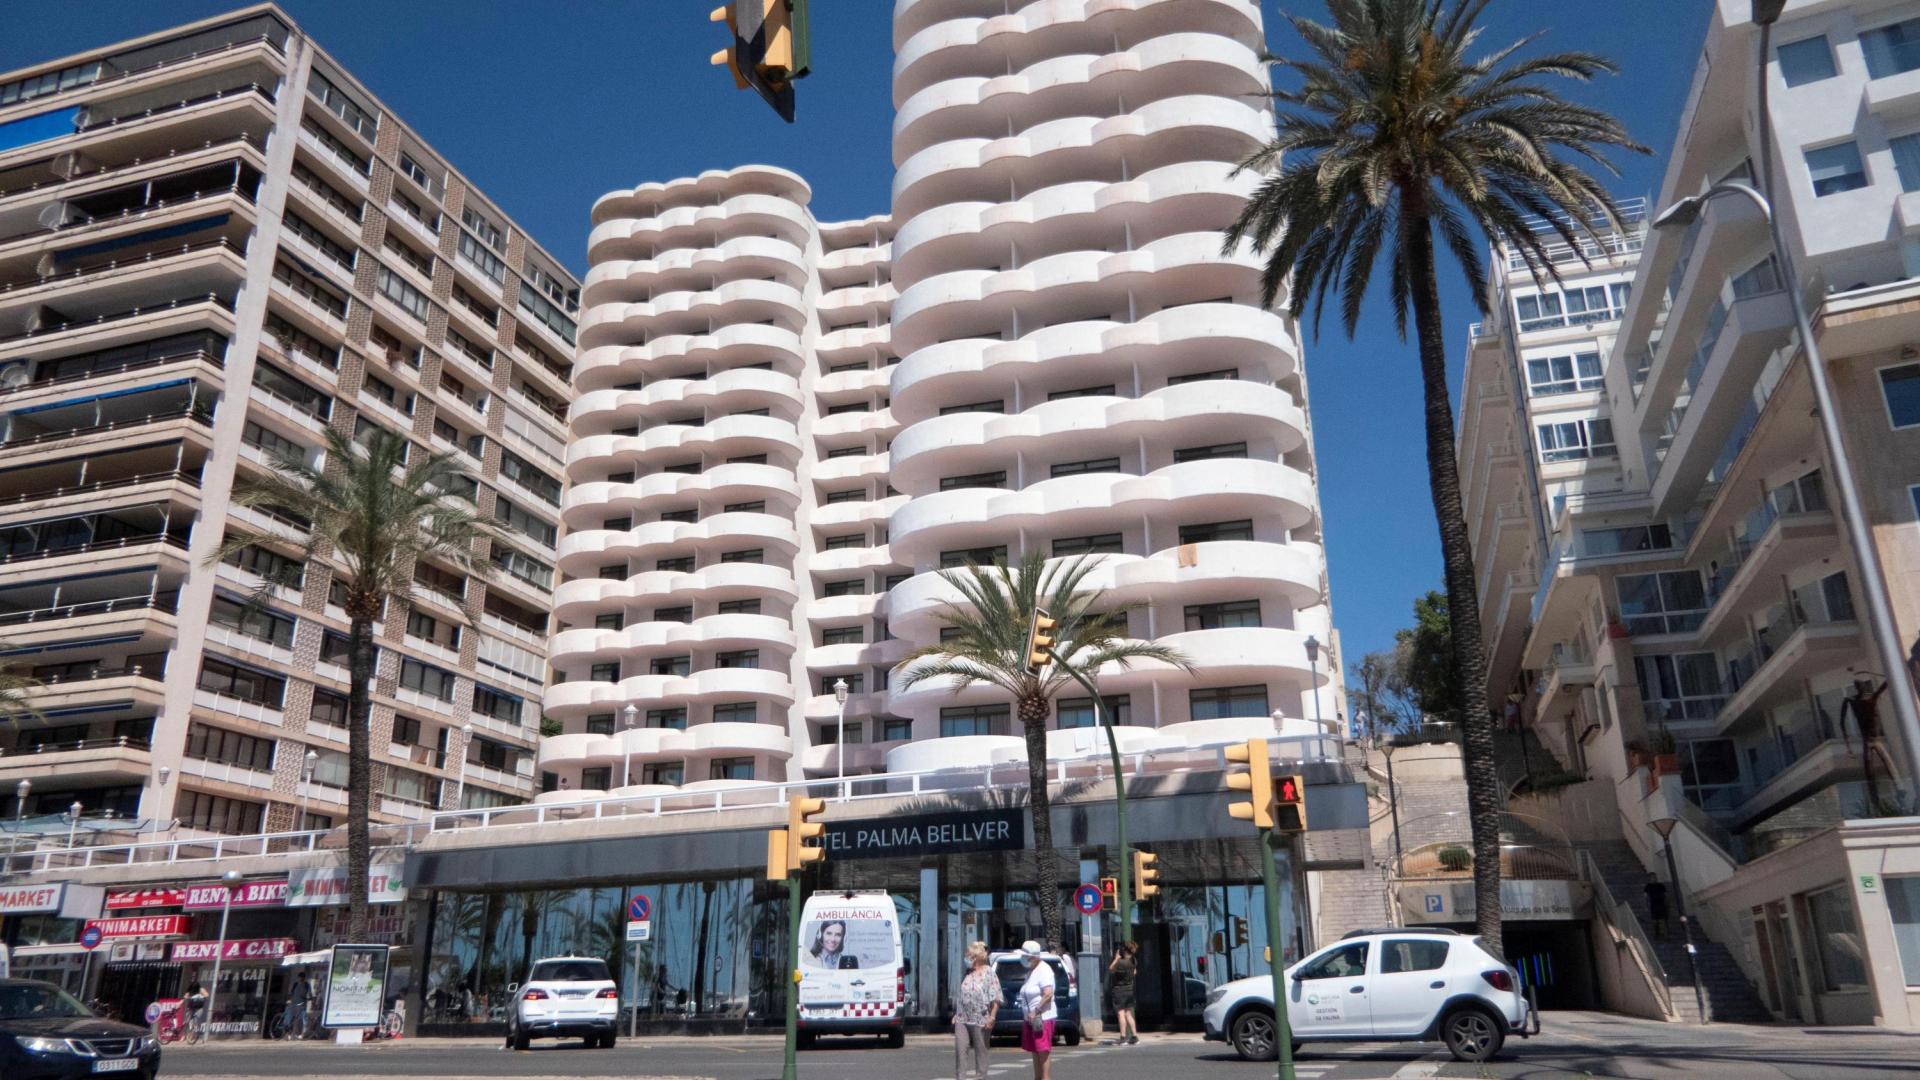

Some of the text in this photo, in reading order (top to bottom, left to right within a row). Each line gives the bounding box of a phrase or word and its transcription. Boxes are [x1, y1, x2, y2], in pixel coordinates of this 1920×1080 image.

[857, 827, 922, 849] PALMA
[927, 821, 1010, 844] BELLVER
[234, 888, 243, 902] A
[247, 883, 288, 902] BIKE
[226, 942, 240, 957] A
[245, 940, 285, 956] CAR
